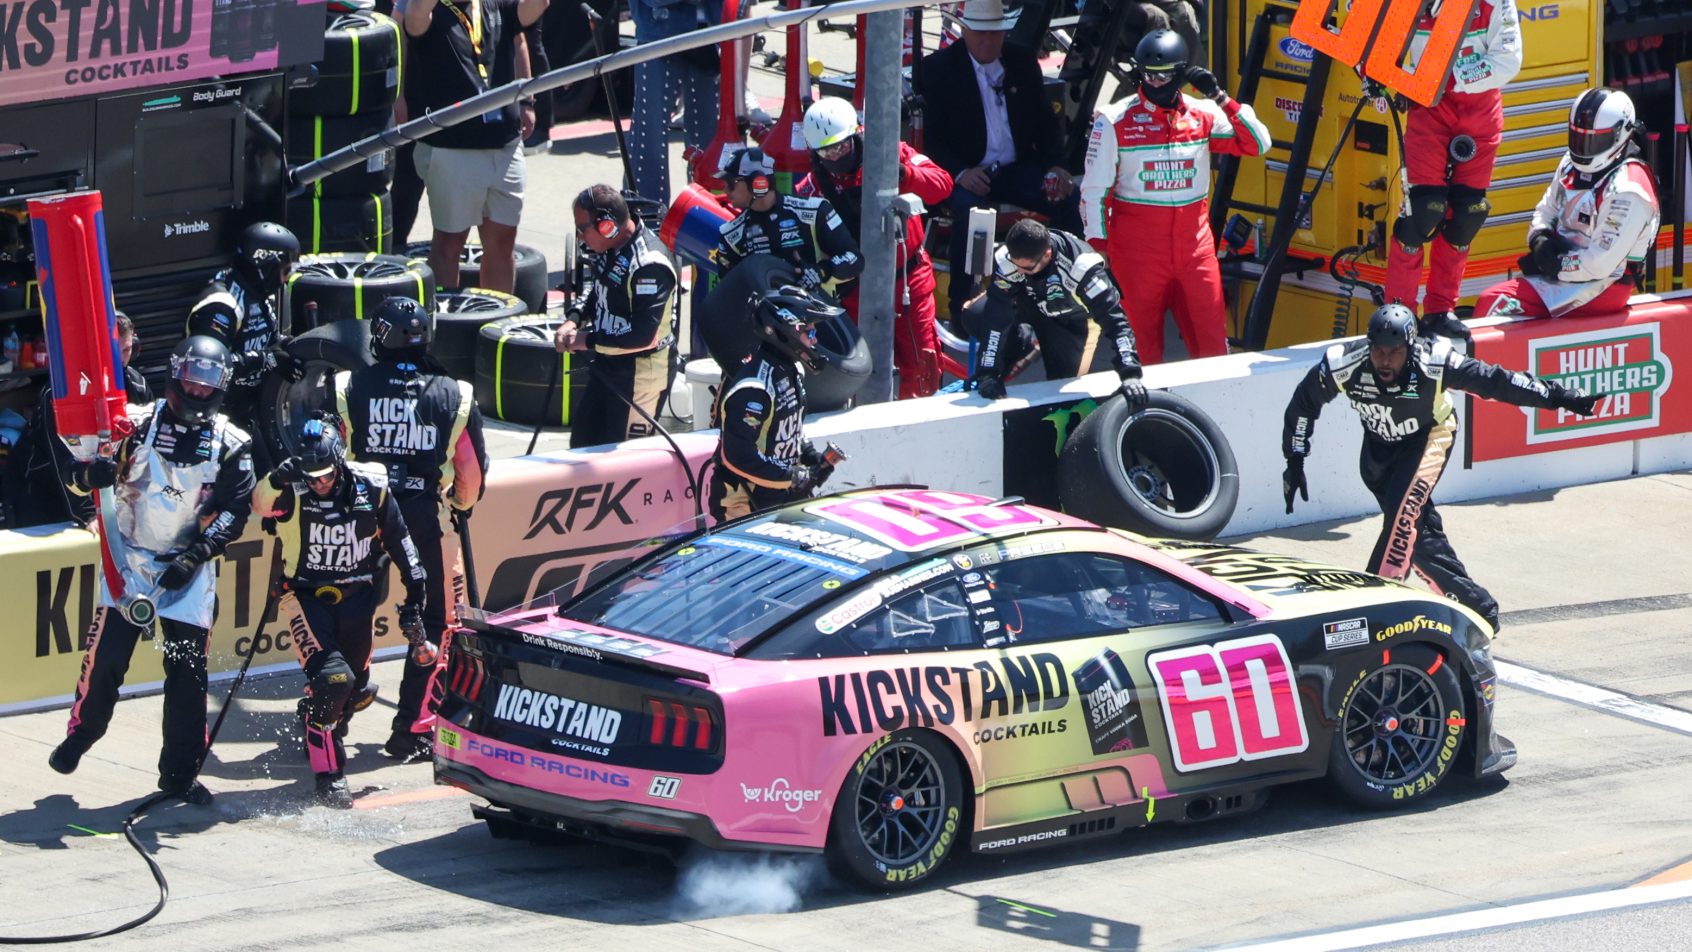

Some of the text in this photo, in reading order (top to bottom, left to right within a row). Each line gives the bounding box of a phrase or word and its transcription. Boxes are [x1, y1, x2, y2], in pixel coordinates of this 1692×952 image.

[1287, 39, 1314, 59] Ford
[64, 53, 189, 85] COCKTAILS
[192, 87, 242, 102] Body Guard
[1142, 169, 1195, 181] BROTHERS
[1154, 161, 1186, 171] HUNT
[1154, 180, 1187, 189] PIZZA
[174, 220, 210, 235] Trimble
[1559, 343, 1629, 375] HUNT
[1550, 365, 1657, 396] OTHERS
[369, 398, 418, 424] KICK
[367, 423, 437, 451] STAND
[522, 478, 642, 540] RFK
[308, 520, 357, 545] KICK
[1386, 478, 1430, 569] KICKSTAND
[307, 536, 373, 567] STAND
[707, 537, 860, 576] FORD RACING
[1331, 631, 1363, 644] CUP SERIES
[1336, 620, 1361, 630] NASCAR
[1376, 615, 1453, 642] GOODYEAR
[523, 633, 603, 661] Drink Responsibly.
[818, 652, 1069, 737] KICKSTAND
[1087, 680, 1117, 710] KICK
[1091, 688, 1131, 724] STAND
[1150, 636, 1307, 771] 60
[494, 683, 622, 745] KICKSTAND
[973, 719, 1067, 746] COCKTAILS
[551, 737, 610, 757] COCKTAILS
[856, 733, 893, 776] EAGLE
[467, 740, 630, 788] FORD RACING
[648, 776, 682, 800] 60
[763, 777, 822, 813] Kroger
[886, 806, 960, 882] GOODYEAR
[979, 828, 1067, 850] FORD RACING
